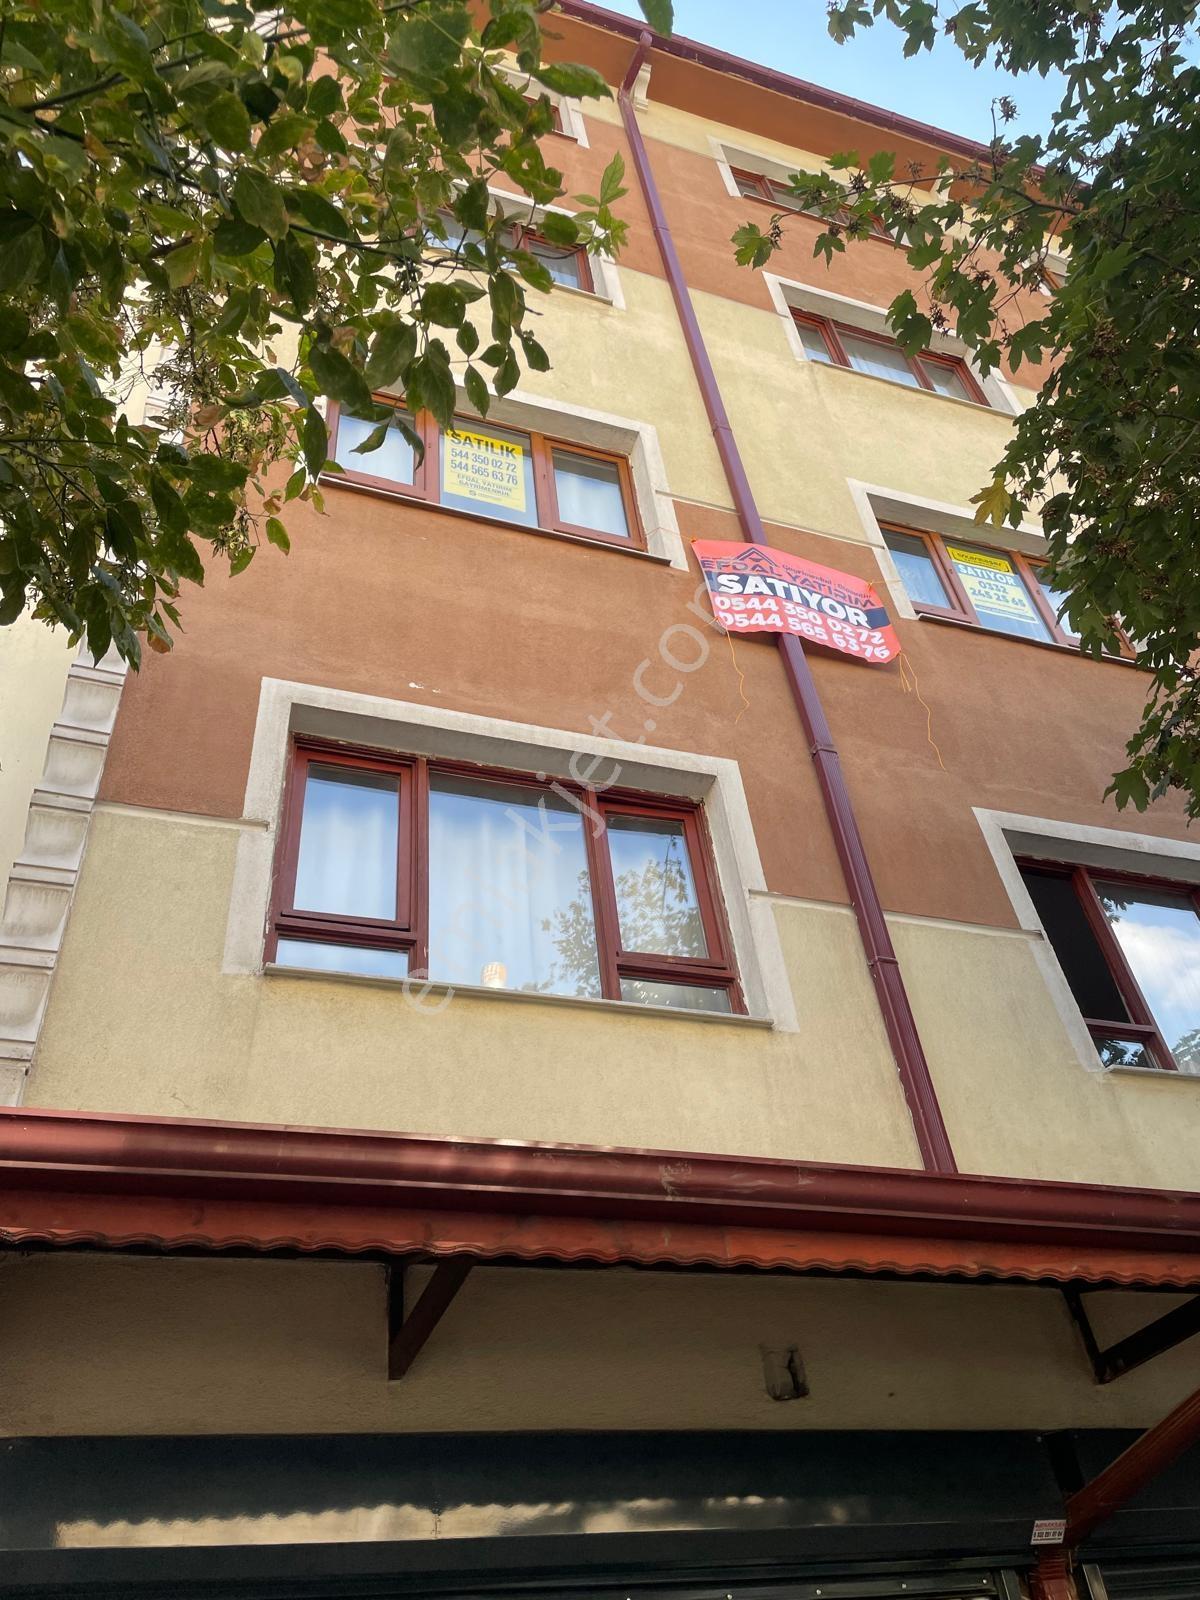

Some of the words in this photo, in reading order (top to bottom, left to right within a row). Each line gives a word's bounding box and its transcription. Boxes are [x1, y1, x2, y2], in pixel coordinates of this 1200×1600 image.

[450, 433, 517, 459] SATILIK
[451, 448, 469, 460] 544
[472, 453, 489, 466] 350
[491, 458, 503, 469] 02
[506, 462, 517, 474] 72
[450, 459, 469, 472] 544
[471, 464, 489, 478] 565
[492, 470, 504, 482] 63
[506, 474, 518, 486] 76
[700, 559, 782, 577] EFDAL
[787, 571, 876, 608] YATIRIM
[957, 564, 1016, 586] SATIYOR
[715, 595, 779, 611] 0544
[783, 602, 823, 625] 350
[827, 618, 885, 645] 0272
[716, 573, 873, 630] SATIYOR
[718, 611, 784, 628] 0544
[788, 616, 829, 641] 565
[832, 632, 890, 659] 6376
